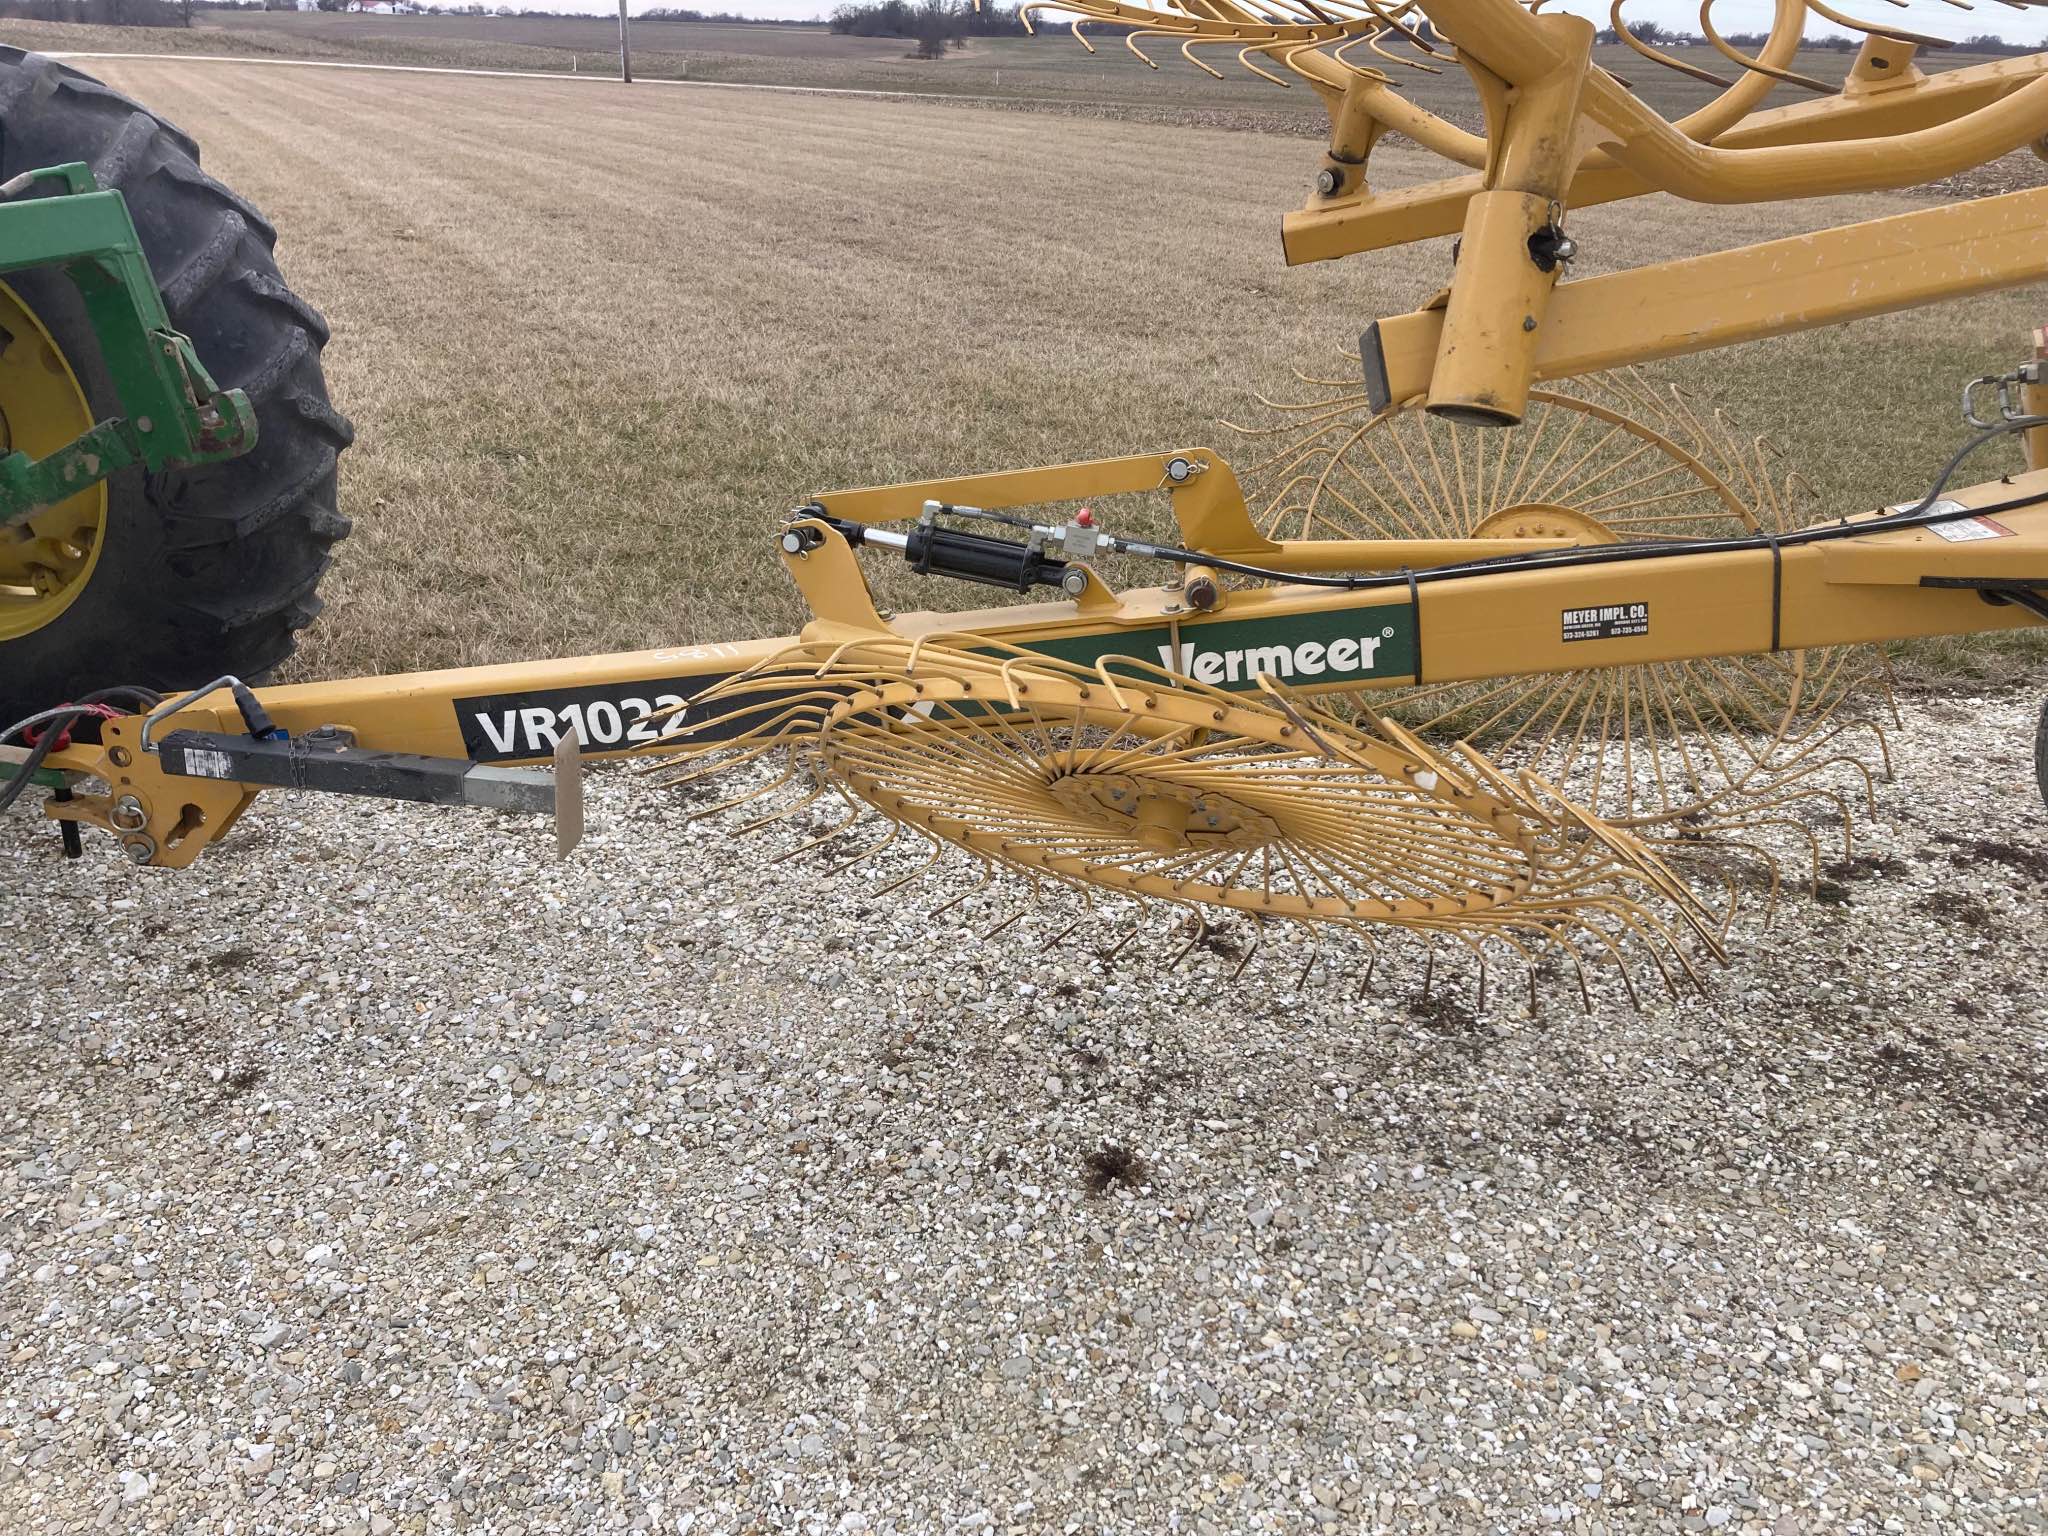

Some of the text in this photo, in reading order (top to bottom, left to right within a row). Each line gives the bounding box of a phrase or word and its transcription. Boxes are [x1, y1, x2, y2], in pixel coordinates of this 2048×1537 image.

[1563, 610, 1598, 624] MEYER
[1600, 607, 1628, 621] IMPL.
[1630, 605, 1648, 618] CO.
[475, 693, 694, 753] VR1022
